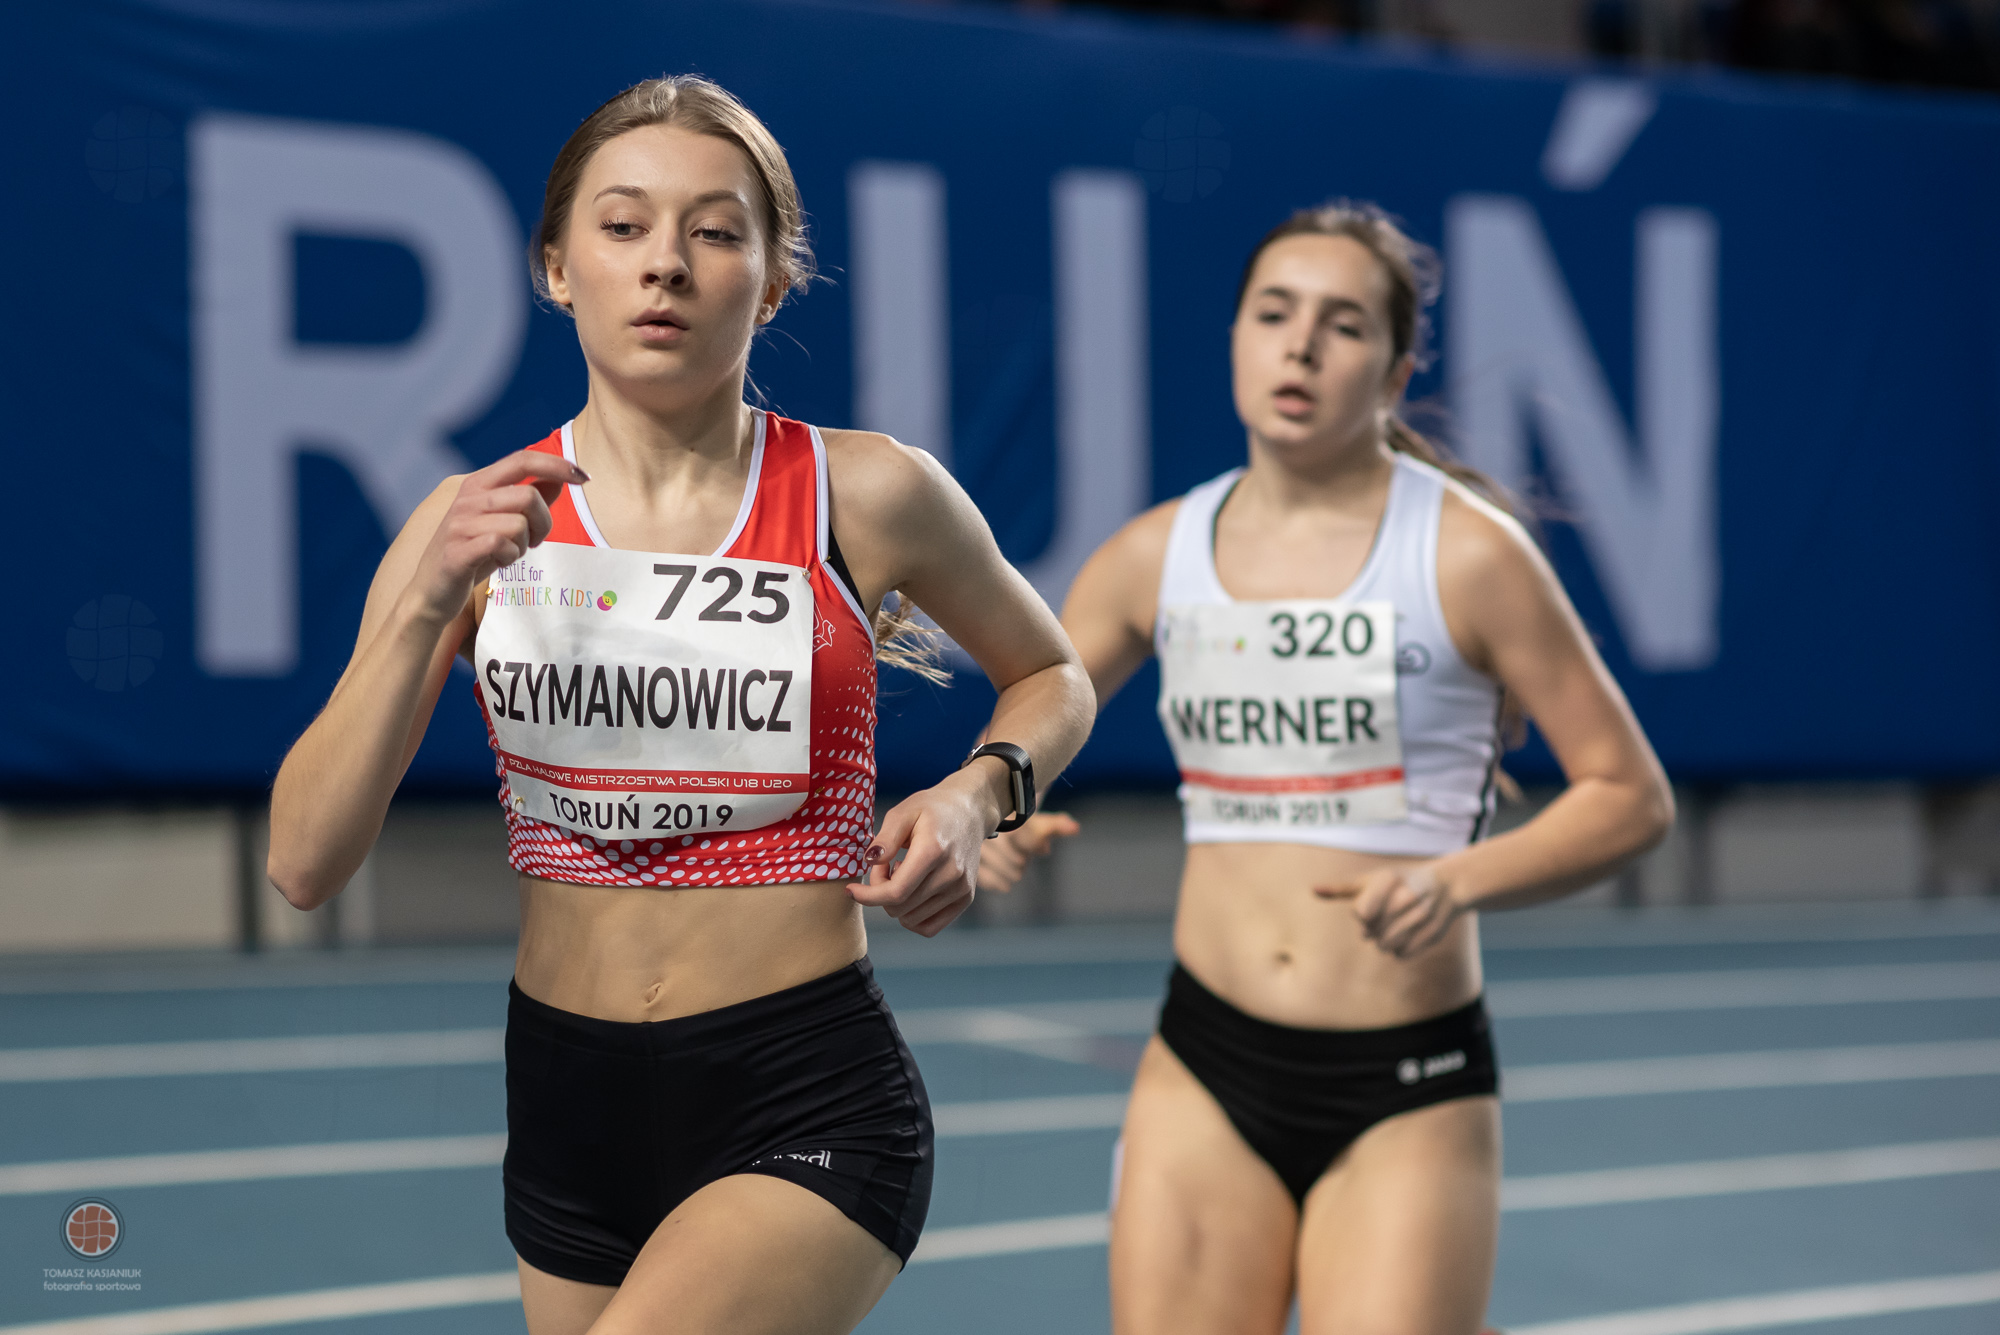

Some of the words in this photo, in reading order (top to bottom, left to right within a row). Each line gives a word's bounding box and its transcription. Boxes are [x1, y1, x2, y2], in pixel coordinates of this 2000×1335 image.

[498, 560, 526, 582] NESTLÉ
[529, 566, 544, 582] for
[495, 586, 552, 606] HEALTHIER
[560, 588, 593, 608] KIDS
[653, 563, 790, 624] 725
[1269, 611, 1375, 659] 320
[485, 658, 794, 733] SZYMANOWICZ
[1170, 697, 1379, 745] WERNER
[508, 758, 533, 774] PZLA
[533, 765, 572, 783] HALOWE
[574, 774, 676, 787] MISTRZOSTWA
[679, 776, 730, 788] POLSKI
[733, 778, 759, 789] U18
[762, 779, 793, 789] U20
[549, 793, 640, 830] TORUŃ
[652, 803, 734, 830] 2019
